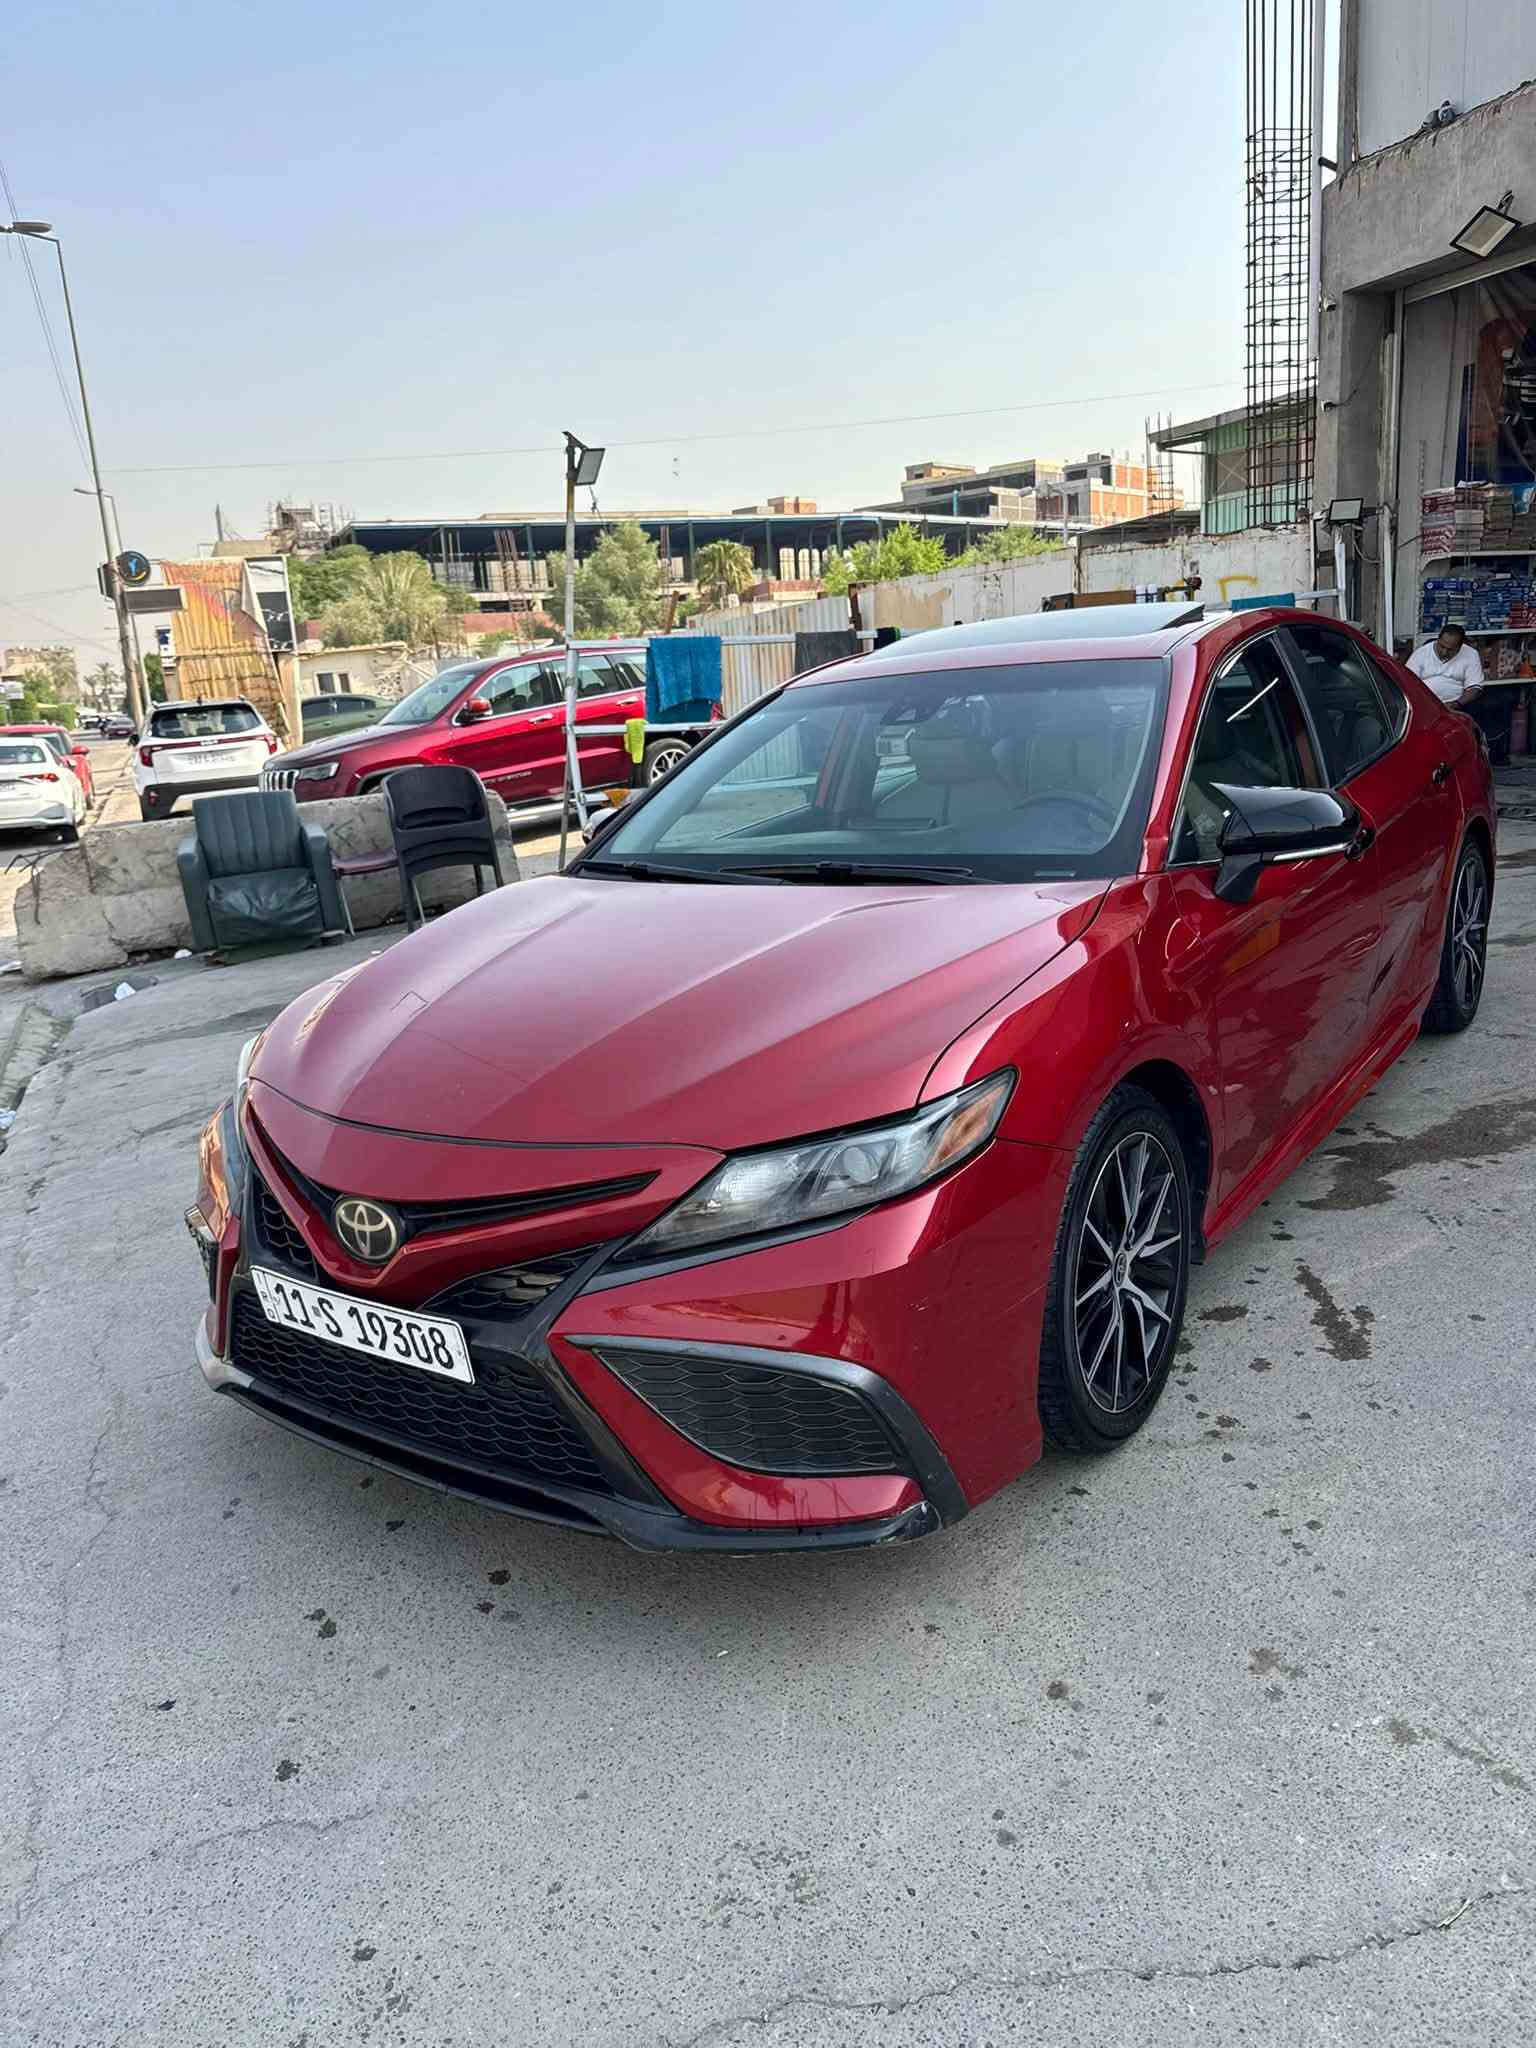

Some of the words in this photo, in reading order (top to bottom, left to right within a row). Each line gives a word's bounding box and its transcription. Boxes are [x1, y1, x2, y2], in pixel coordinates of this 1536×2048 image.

[274, 1283, 316, 1329] 11
[317, 1296, 343, 1338] S
[347, 1305, 455, 1370] 19308
